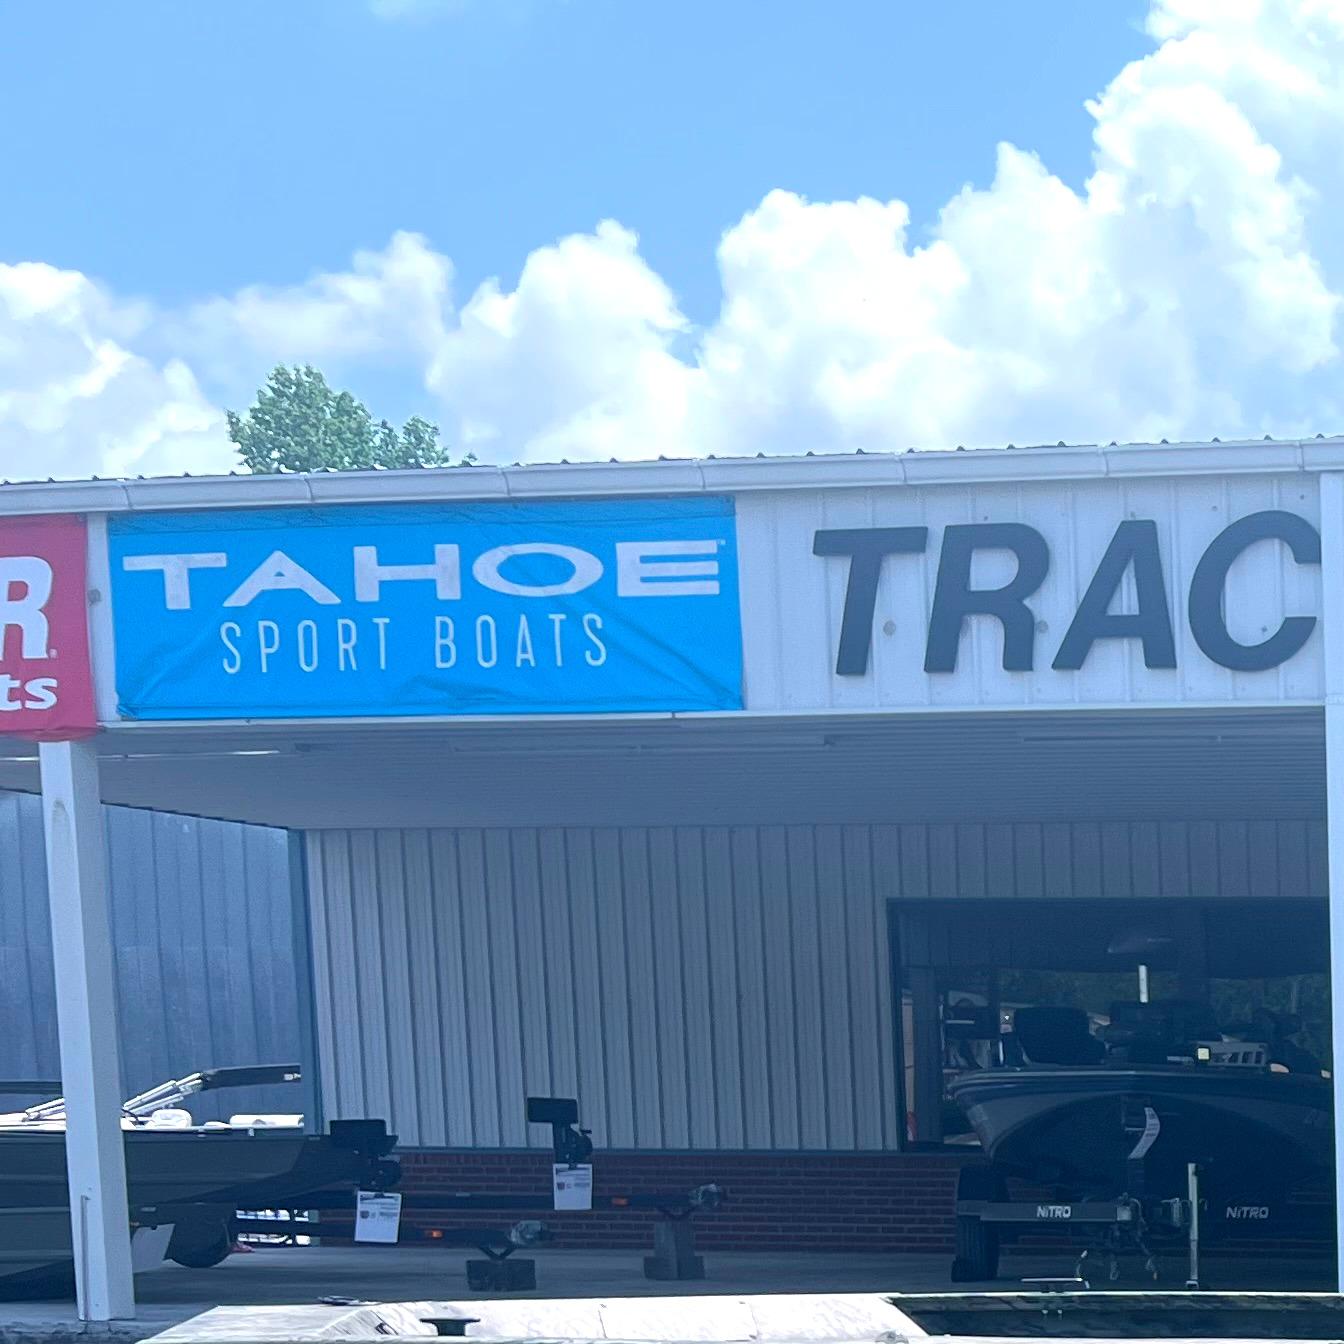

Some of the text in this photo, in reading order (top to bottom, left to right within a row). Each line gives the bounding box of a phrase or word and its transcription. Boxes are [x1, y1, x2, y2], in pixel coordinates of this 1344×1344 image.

[122, 540, 721, 610] TAHOE
[221, 613, 608, 675] SPORT BOATS
